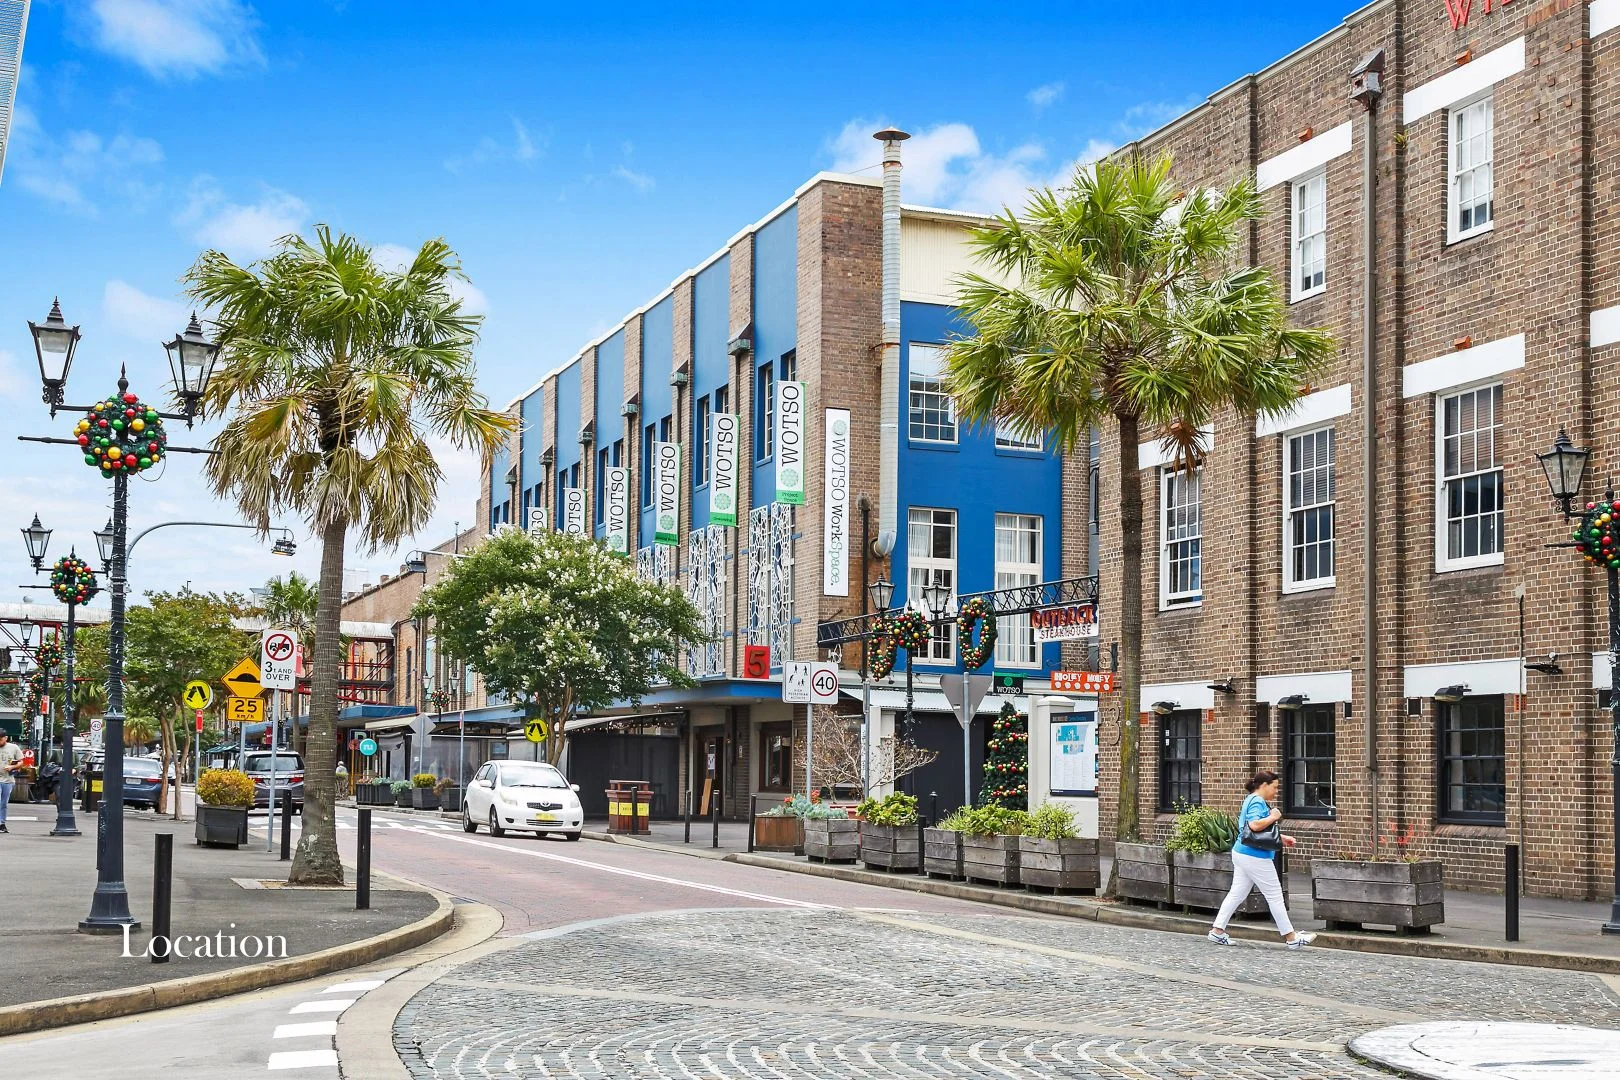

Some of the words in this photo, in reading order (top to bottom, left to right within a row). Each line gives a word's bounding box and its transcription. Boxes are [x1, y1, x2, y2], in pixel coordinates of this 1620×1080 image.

[781, 385, 799, 467] WOTSO
[716, 417, 734, 491] WOTSO
[660, 446, 676, 512] WOTSO
[831, 438, 845, 500] WOTSO
[568, 491, 581, 535] OTSO
[610, 470, 624, 533] WOTSO
[1031, 605, 1094, 629] OUTBACK
[1040, 625, 1091, 639] STEAKHOUSE
[266, 673, 290, 681] OVER
[748, 650, 766, 677] 5
[815, 676, 834, 690] 40
[996, 686, 1020, 694] WOTSO
[234, 700, 257, 713] 25
